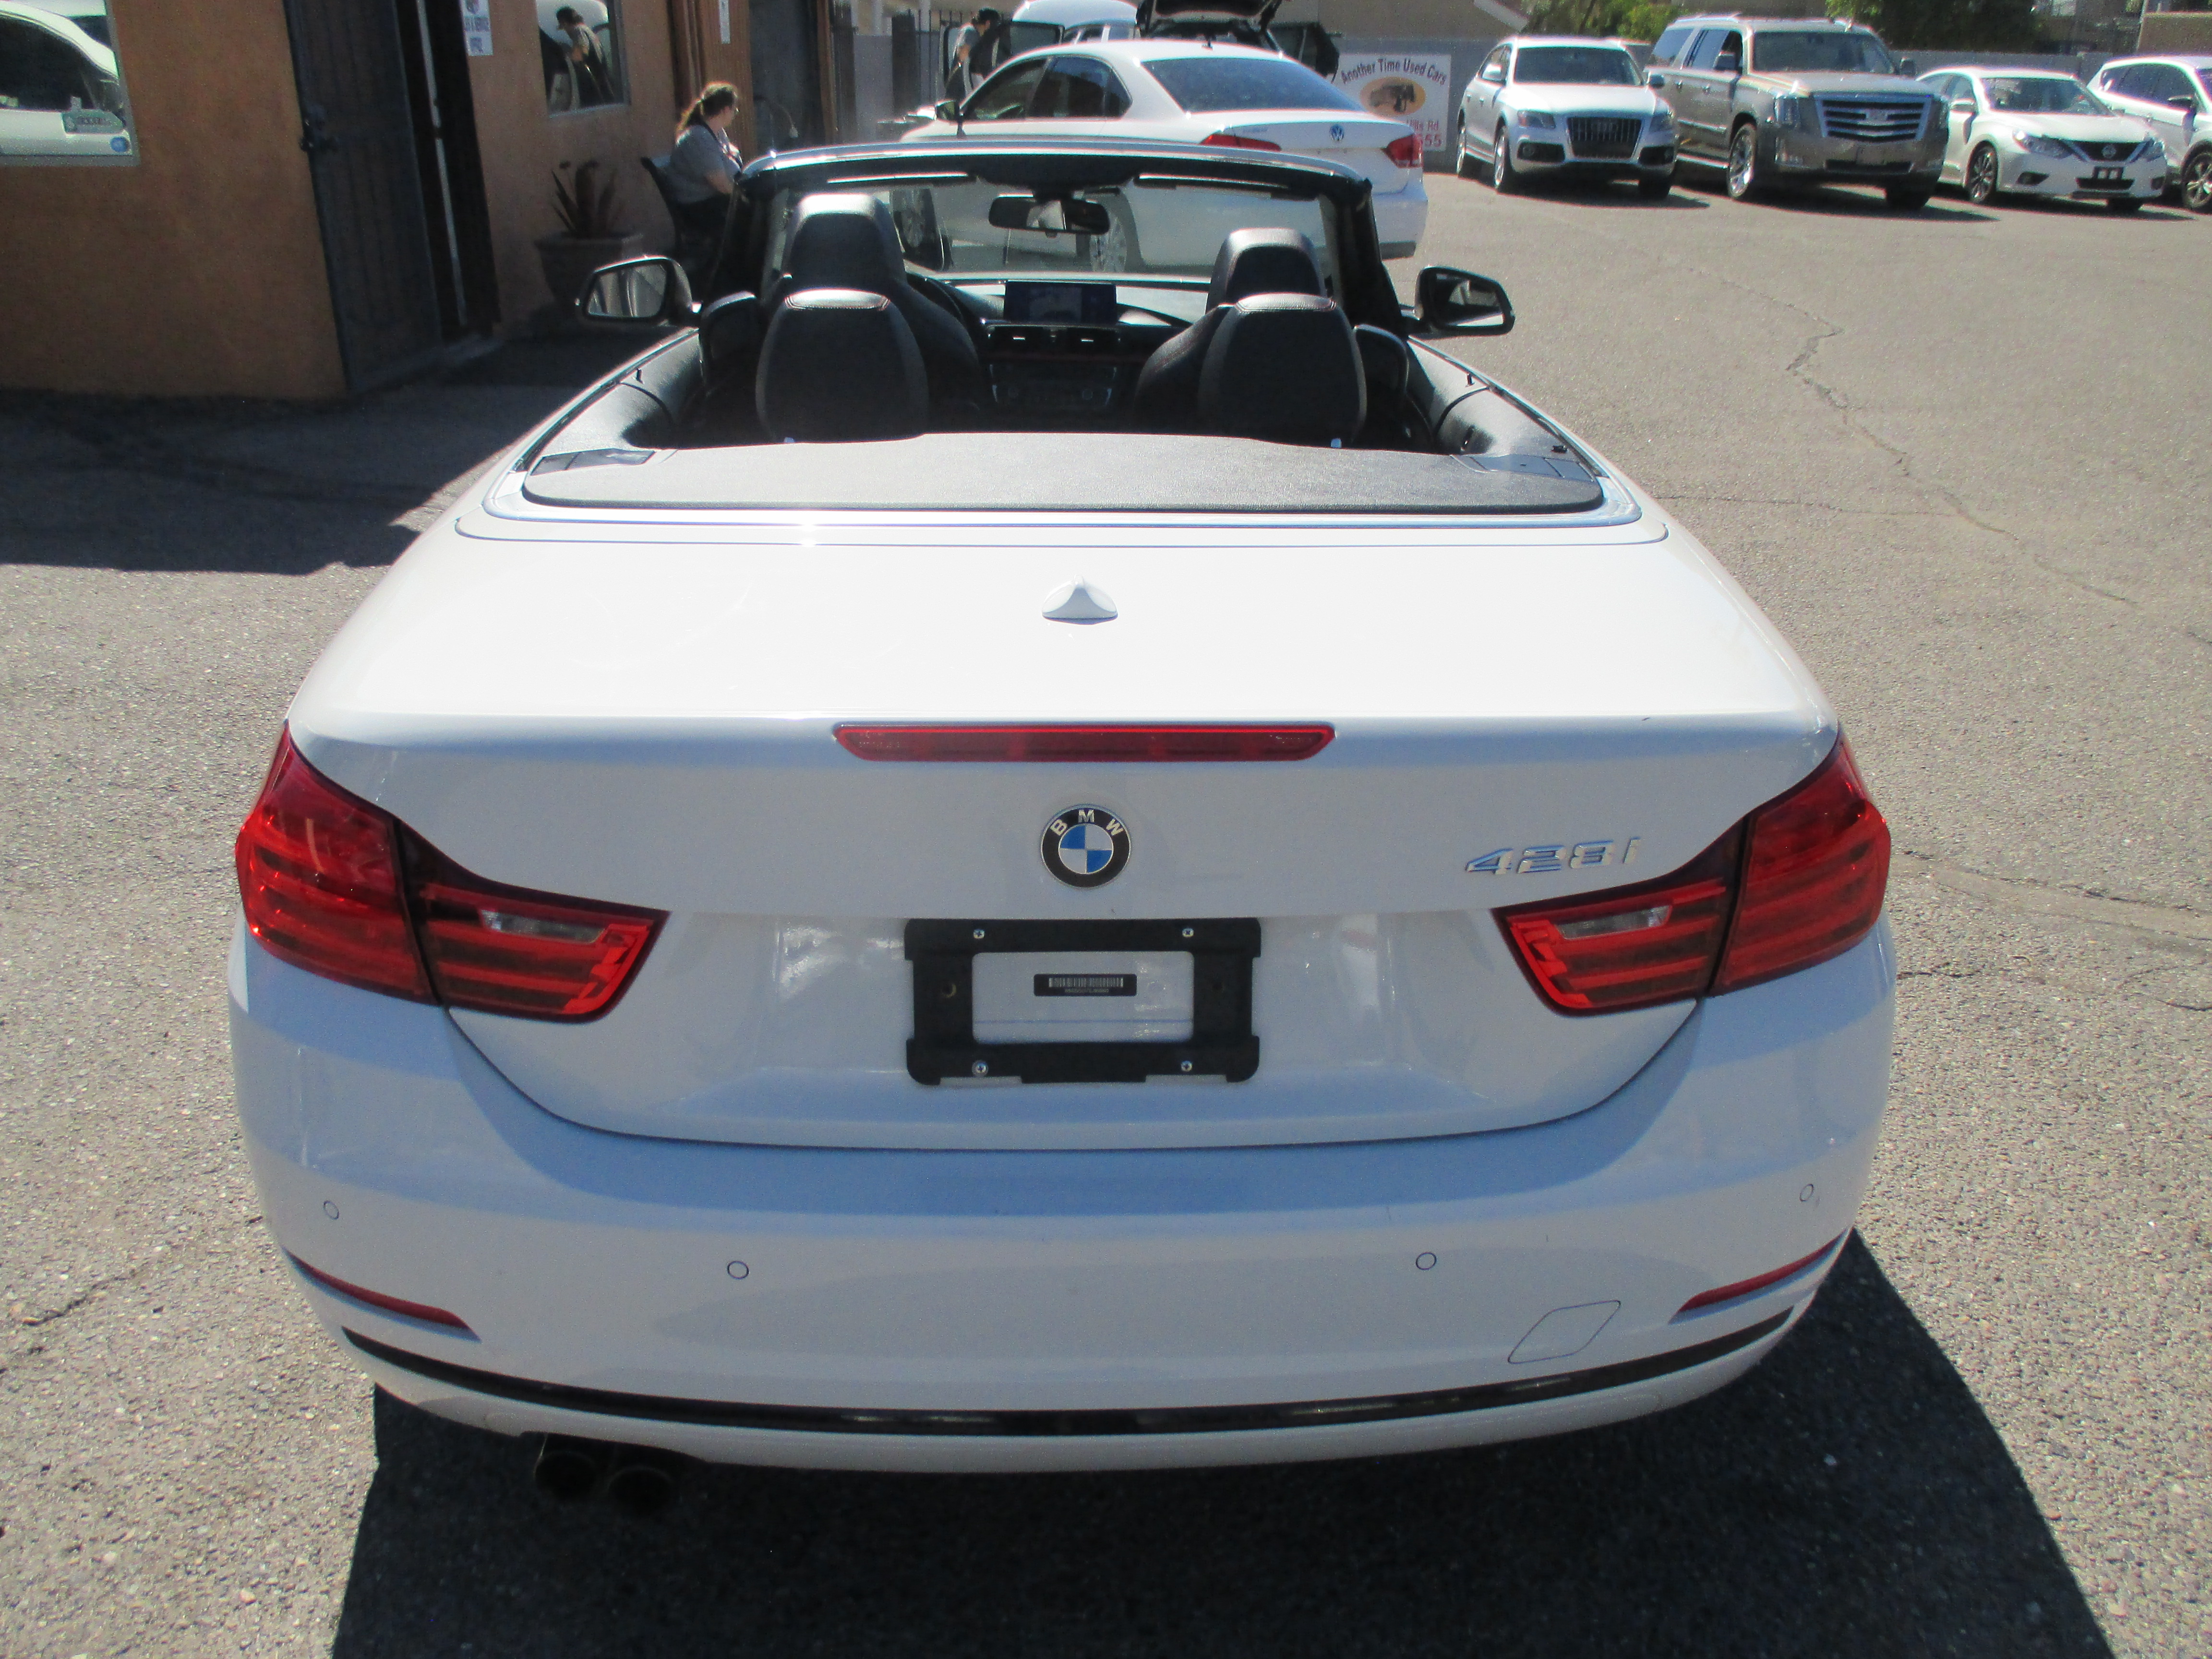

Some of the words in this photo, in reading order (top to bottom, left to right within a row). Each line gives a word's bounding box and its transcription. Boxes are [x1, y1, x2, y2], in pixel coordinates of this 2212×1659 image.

[1341, 61, 1376, 84] Another
[1377, 58, 1400, 72] Time
[1403, 58, 1427, 76] Used
[1427, 63, 1447, 85] Cars
[1049, 809, 1124, 836] BMW
[1465, 836, 1642, 875] 428i
